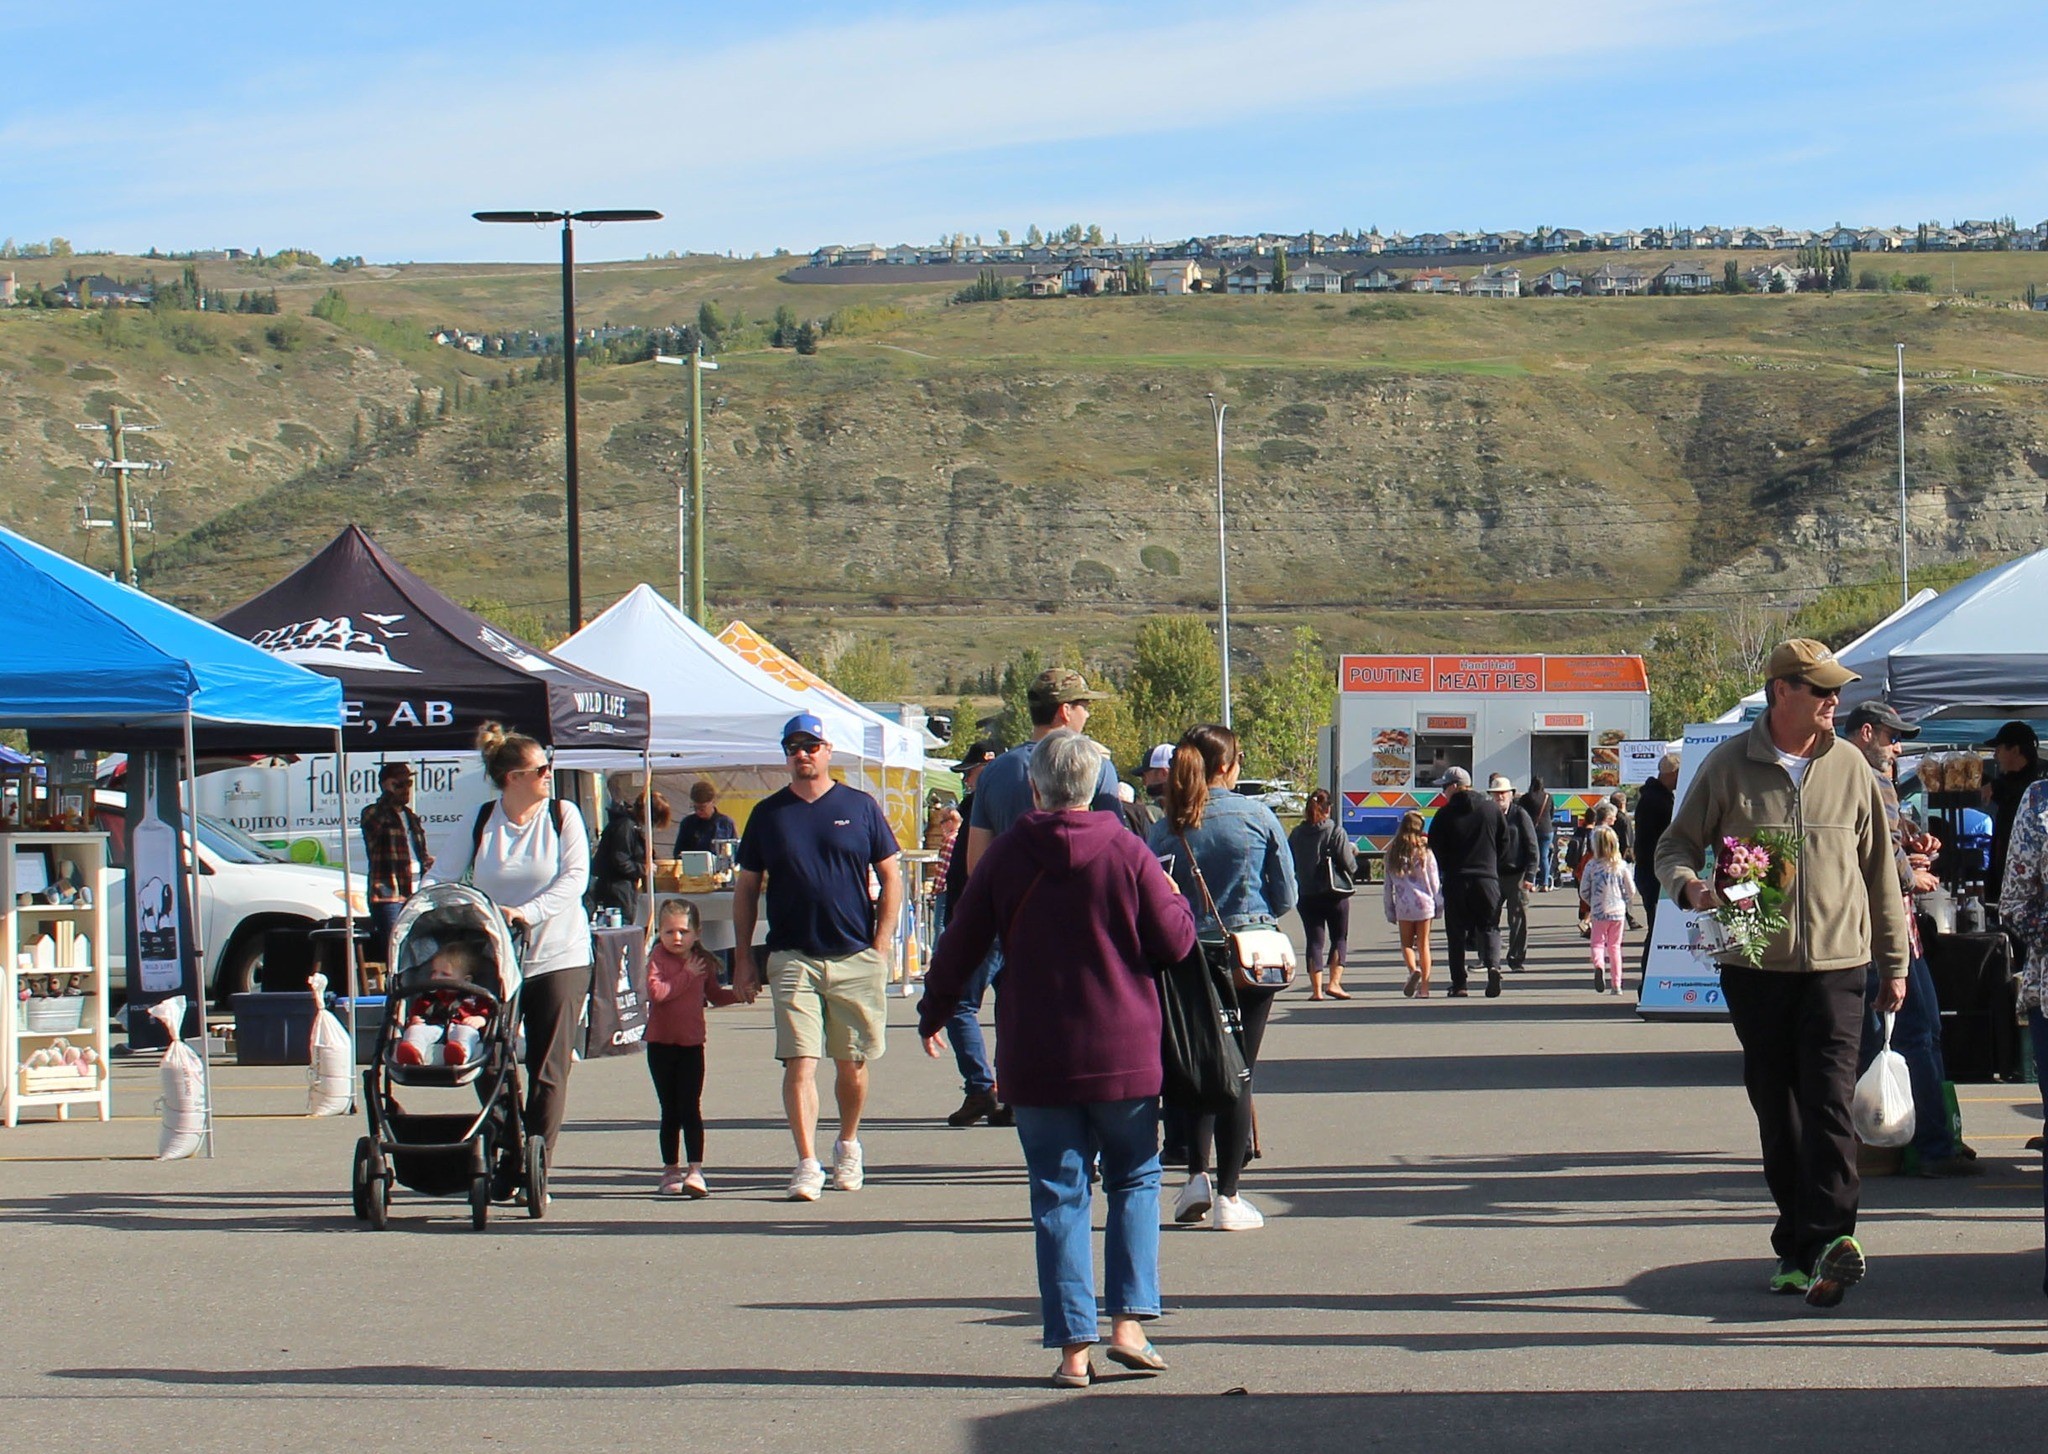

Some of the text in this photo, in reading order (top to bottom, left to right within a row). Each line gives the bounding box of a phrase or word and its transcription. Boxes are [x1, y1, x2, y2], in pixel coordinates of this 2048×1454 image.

[1460, 660, 1488, 671] Hand
[1350, 668, 1424, 683] POUTINE
[1438, 673, 1490, 690] MEAT
[1495, 673, 1537, 690] PIES
[573, 692, 626, 718] WILD LIFE
[387, 701, 454, 727] AB
[1685, 736, 1719, 744] Crystal
[1377, 744, 1405, 755] Sweet
[296, 816, 362, 827] IT'S ALWYS
